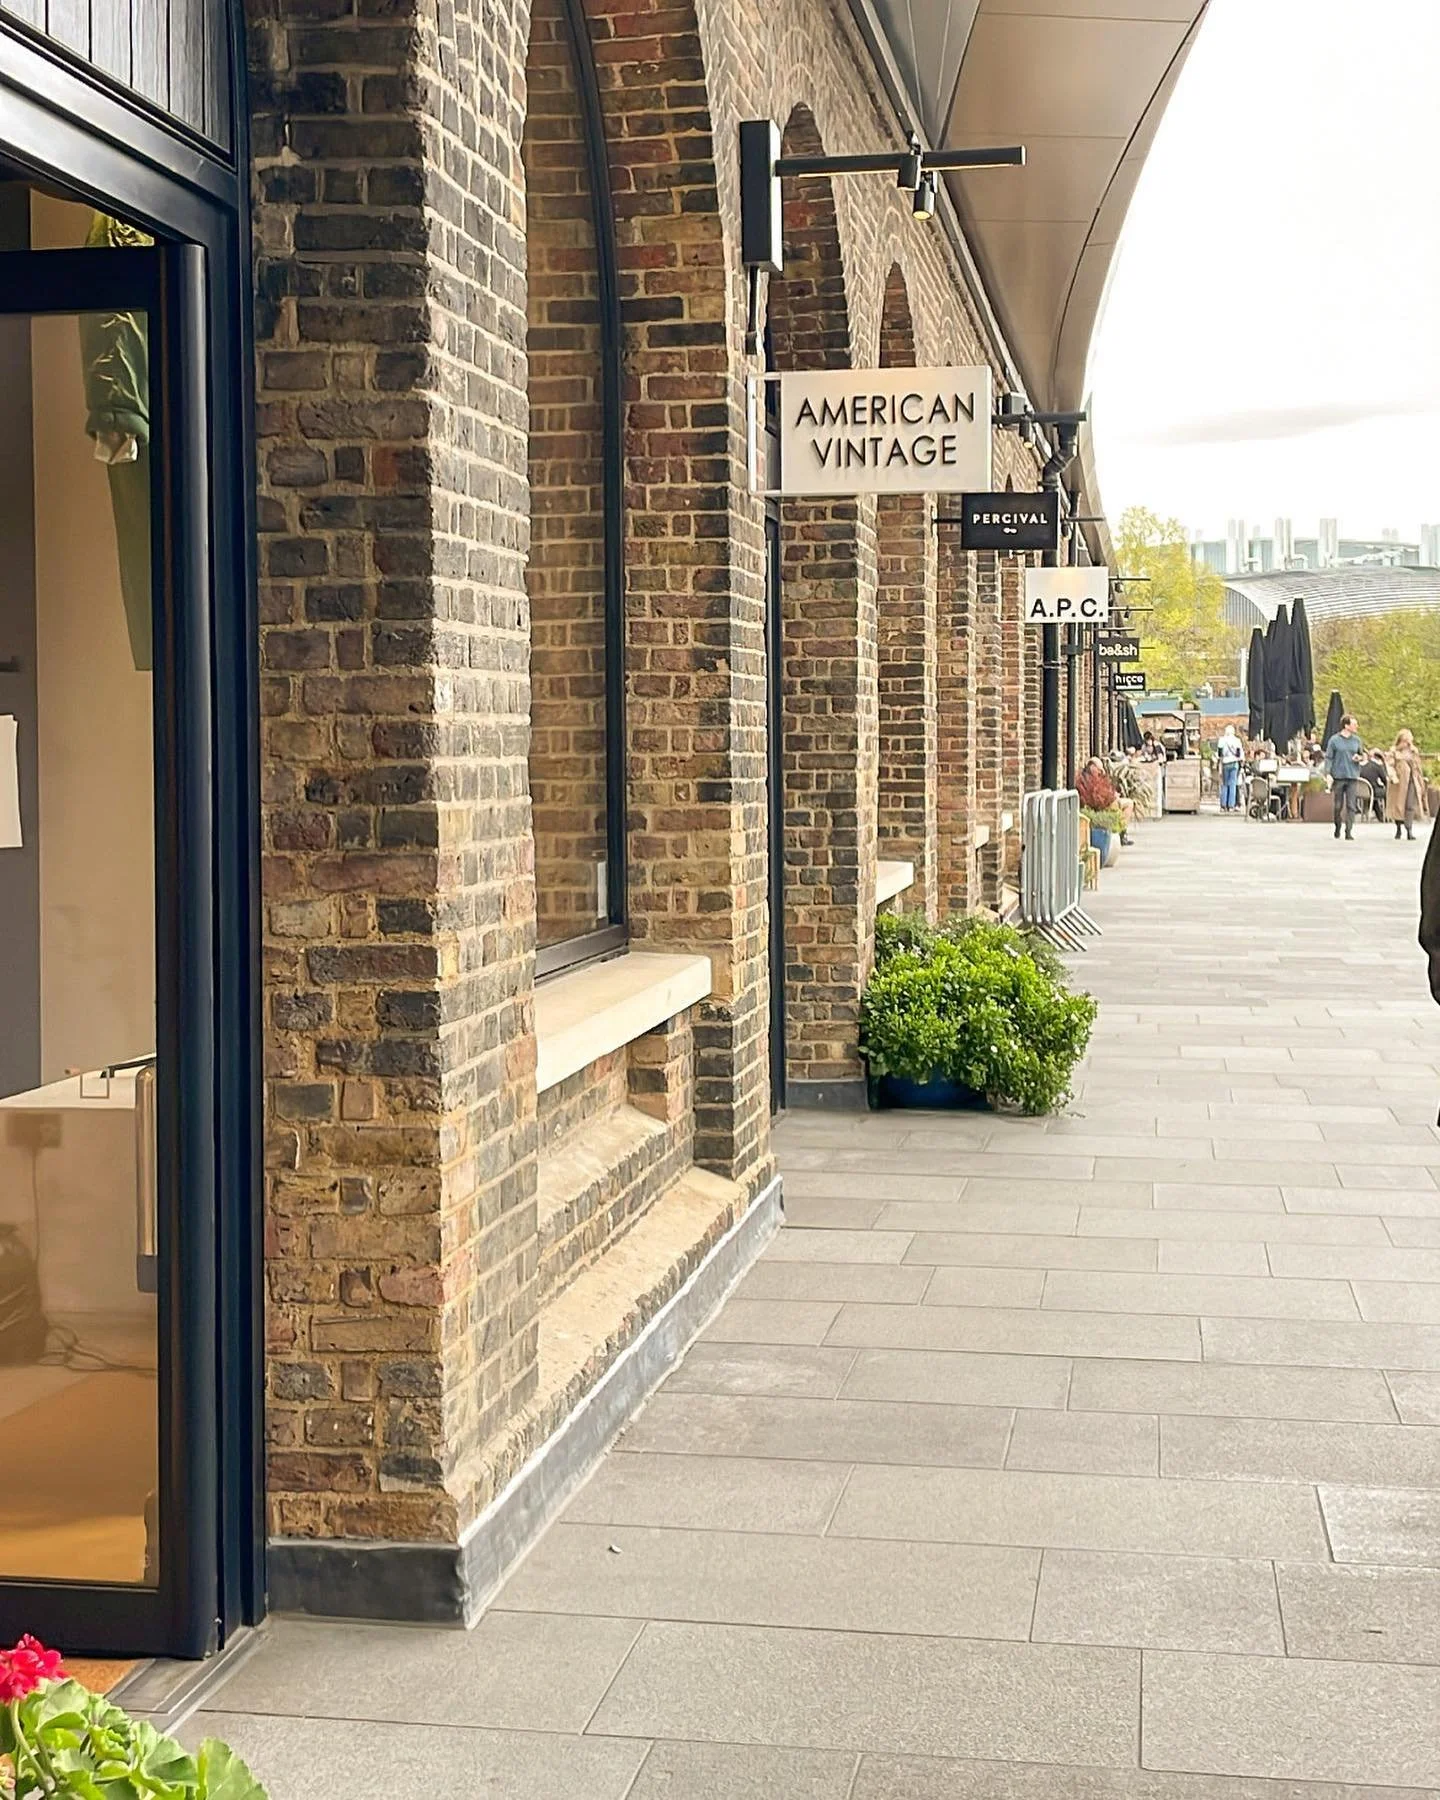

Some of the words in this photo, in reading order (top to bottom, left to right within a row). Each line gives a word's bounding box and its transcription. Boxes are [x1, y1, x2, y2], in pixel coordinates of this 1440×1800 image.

[795, 393, 974, 426] AMERICAN
[812, 435, 957, 468] VINTAGE
[972, 513, 1048, 524] PERCIVAL
[1030, 598, 1104, 617] A.P.C.
[1098, 643, 1138, 656] ba&sh
